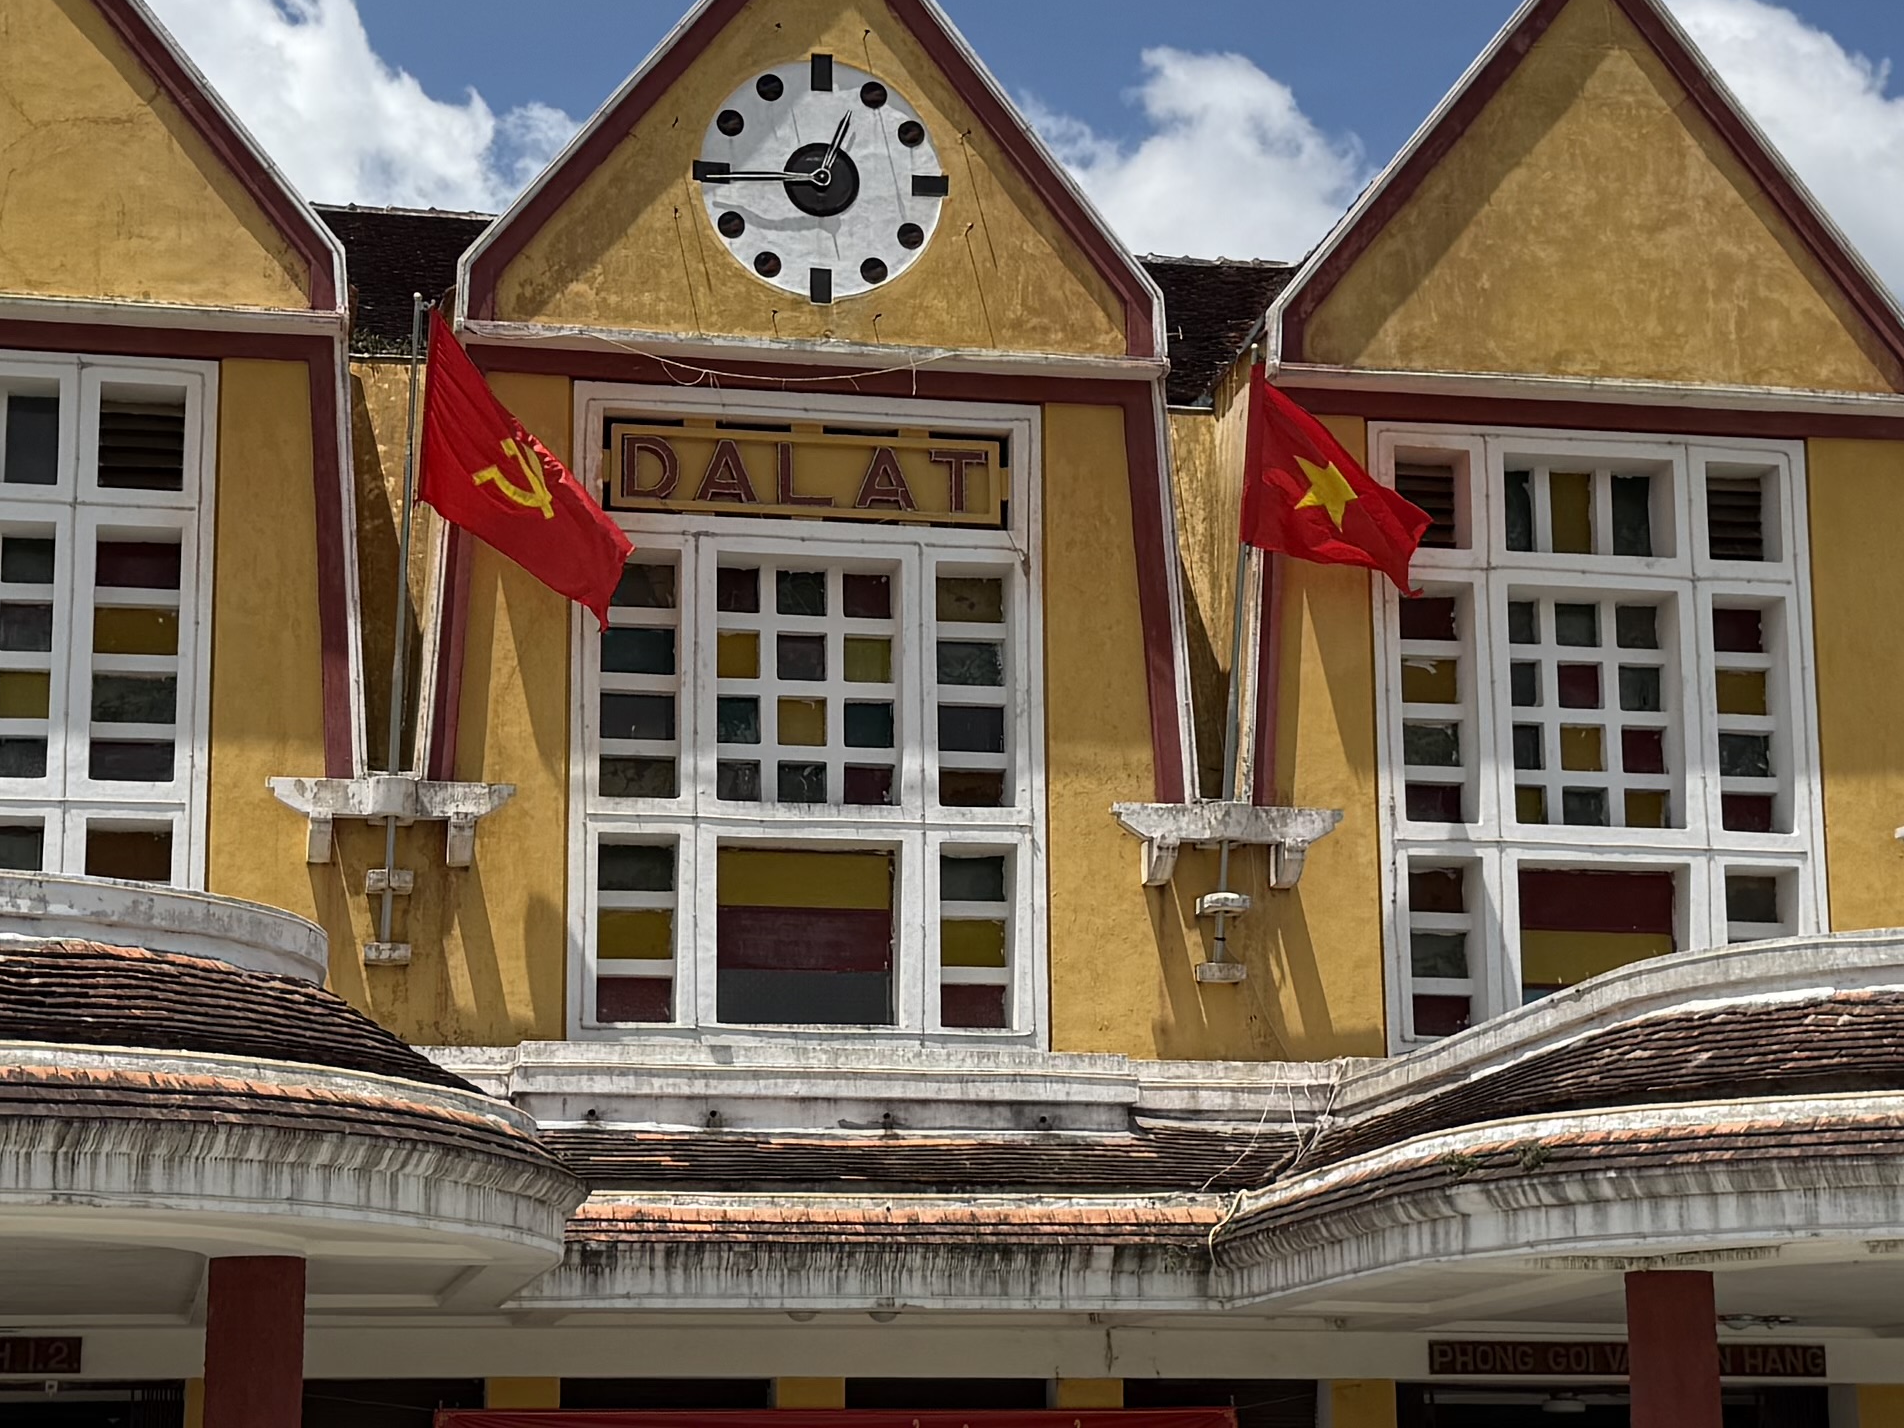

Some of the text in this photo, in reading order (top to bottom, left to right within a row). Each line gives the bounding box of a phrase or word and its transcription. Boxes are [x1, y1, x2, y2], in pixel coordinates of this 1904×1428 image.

[622, 434, 989, 513] DALAT
[1432, 1343, 1534, 1373] PHONG
[1546, 1345, 1596, 1373] GOI
[1744, 1347, 1825, 1375] HANG
